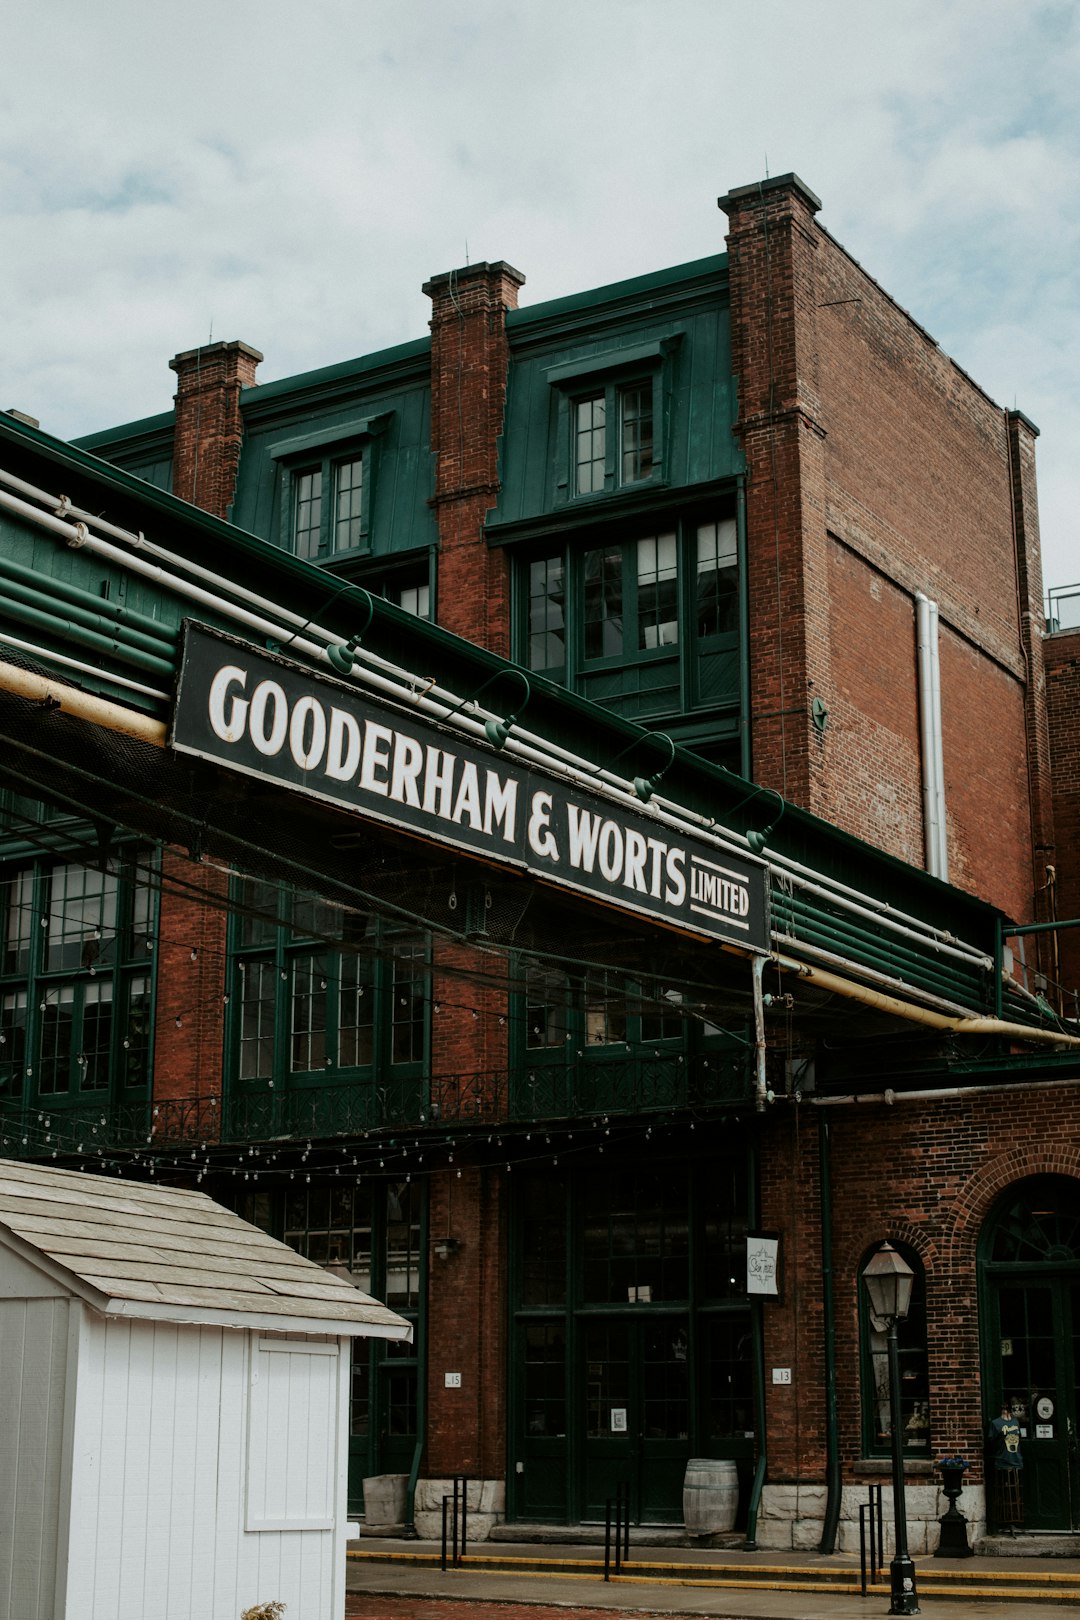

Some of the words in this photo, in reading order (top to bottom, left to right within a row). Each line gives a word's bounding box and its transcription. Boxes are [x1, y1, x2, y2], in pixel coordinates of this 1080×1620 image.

[208, 665, 519, 843] GOODERHAM
[528, 790, 560, 862] &
[566, 802, 687, 906] WORTS
[690, 866, 750, 917] LIMITED
[451, 1376, 460, 1384] 15
[780, 1371, 789, 1381] 13
